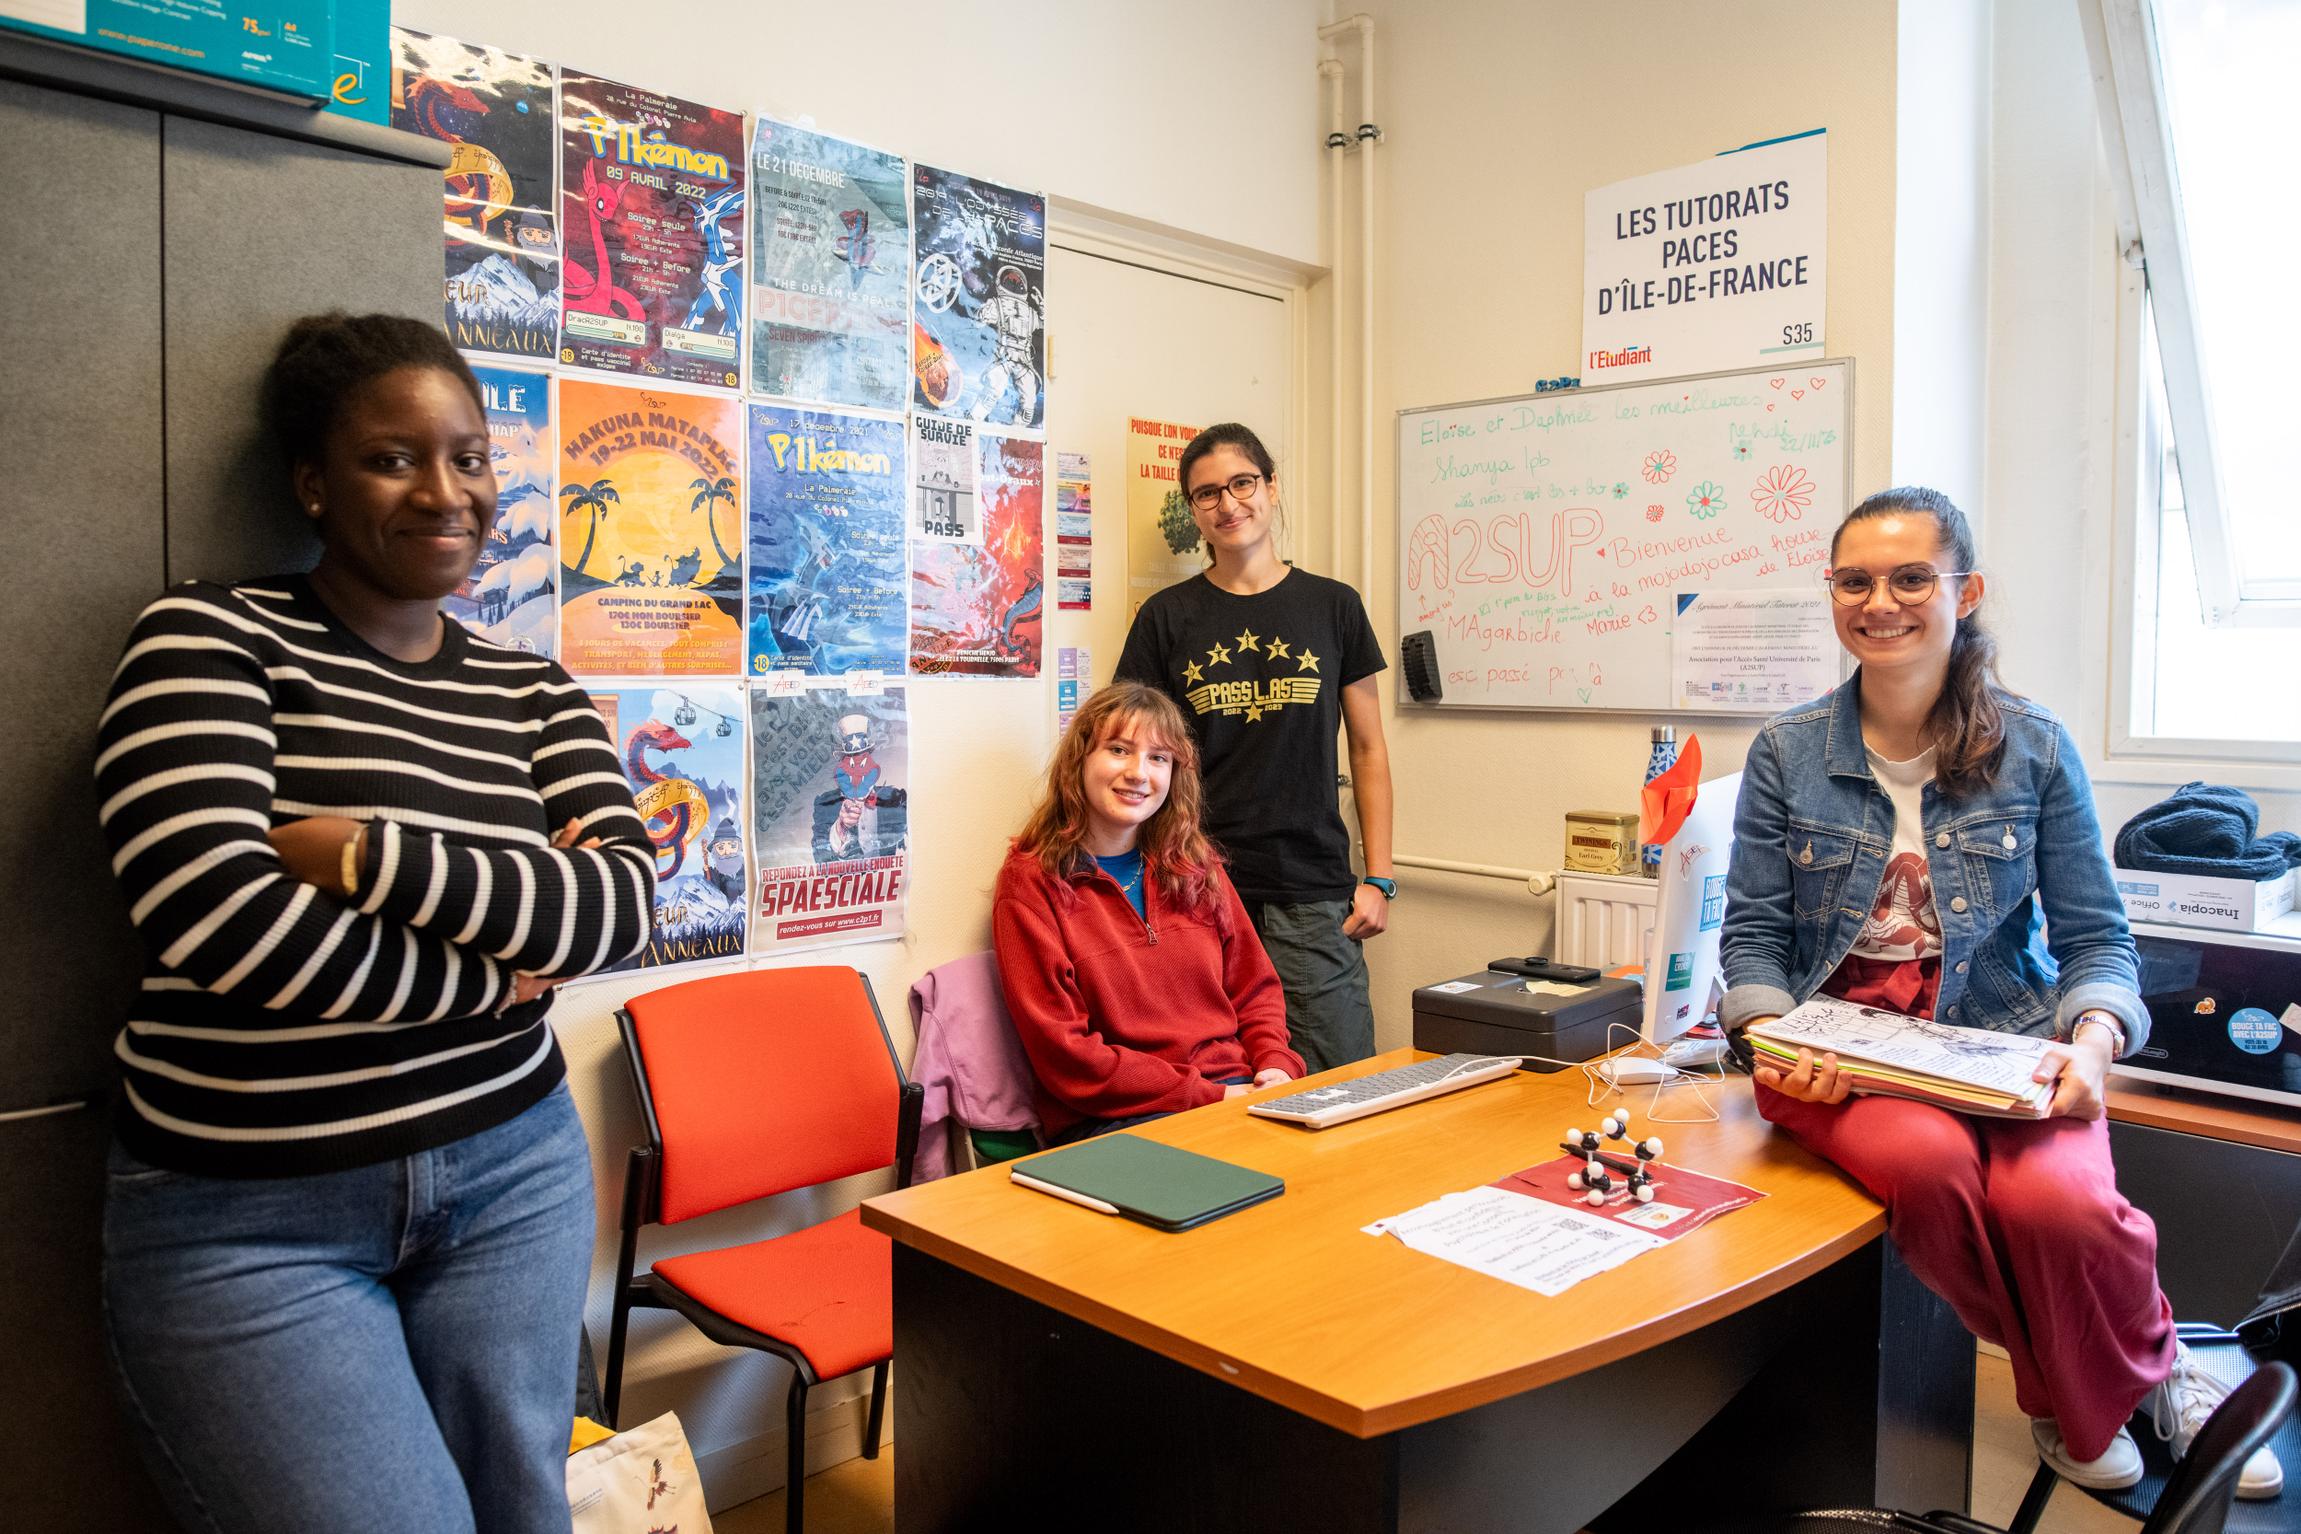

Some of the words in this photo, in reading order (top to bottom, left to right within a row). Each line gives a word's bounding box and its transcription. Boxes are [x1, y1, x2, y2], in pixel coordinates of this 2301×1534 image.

[625, 90, 636, 100] La
[756, 151, 770, 171] LE
[772, 156, 786, 175] 21
[606, 165, 623, 180] 09
[630, 171, 668, 191] AVRIL
[675, 181, 707, 199] 2022
[1616, 206, 1657, 241] LES
[1663, 180, 1790, 231] TUTORATS
[1662, 229, 1738, 269] PACES
[801, 282, 843, 299] DREAM
[847, 292, 858, 300] IS
[1599, 255, 1809, 316] D'ÎLE-DE-FRANCE
[1782, 322, 1813, 346] S35
[564, 411, 645, 461] HAKUNA
[916, 416, 953, 434] GUIDE
[956, 425, 972, 437] DE
[1131, 418, 1162, 437] PUISQUE
[1163, 423, 1178, 439] L'ON
[920, 429, 967, 447] SURVIE
[589, 431, 638, 467] 19-22
[640, 430, 680, 451] MAI
[679, 441, 720, 480] 2022
[1158, 444, 1167, 459] CE
[1140, 463, 1150, 478] LA
[1151, 465, 1176, 481] TAILLE
[804, 483, 815, 492] La
[924, 520, 965, 538] PASS
[1607, 526, 1733, 569] Bienvenue
[1771, 527, 1828, 553] house
[1407, 507, 1605, 598] A2SUP
[1755, 560, 1779, 578] de
[597, 597, 642, 608] CAMPING
[644, 599, 659, 608] DU
[660, 599, 693, 609] GRAND
[694, 600, 712, 609] LAC
[644, 621, 690, 630] BOURSIER
[655, 611, 701, 621] BOURSIER
[1586, 613, 1632, 637] Marie
[1688, 655, 1719, 663] Association
[1753, 655, 1769, 663] Santé
[1769, 655, 1799, 663] Université
[1799, 655, 1806, 663] de
[1209, 680, 1252, 705] PASS
[762, 865, 807, 883] REPONDEZ
[808, 866, 815, 877] A
[816, 863, 827, 877] LA
[828, 859, 869, 875] NOUVELLE
[761, 869, 902, 918] SPAESCIALE
[2180, 903, 2240, 920] Inacopia
[779, 923, 823, 934] rendez-vous
